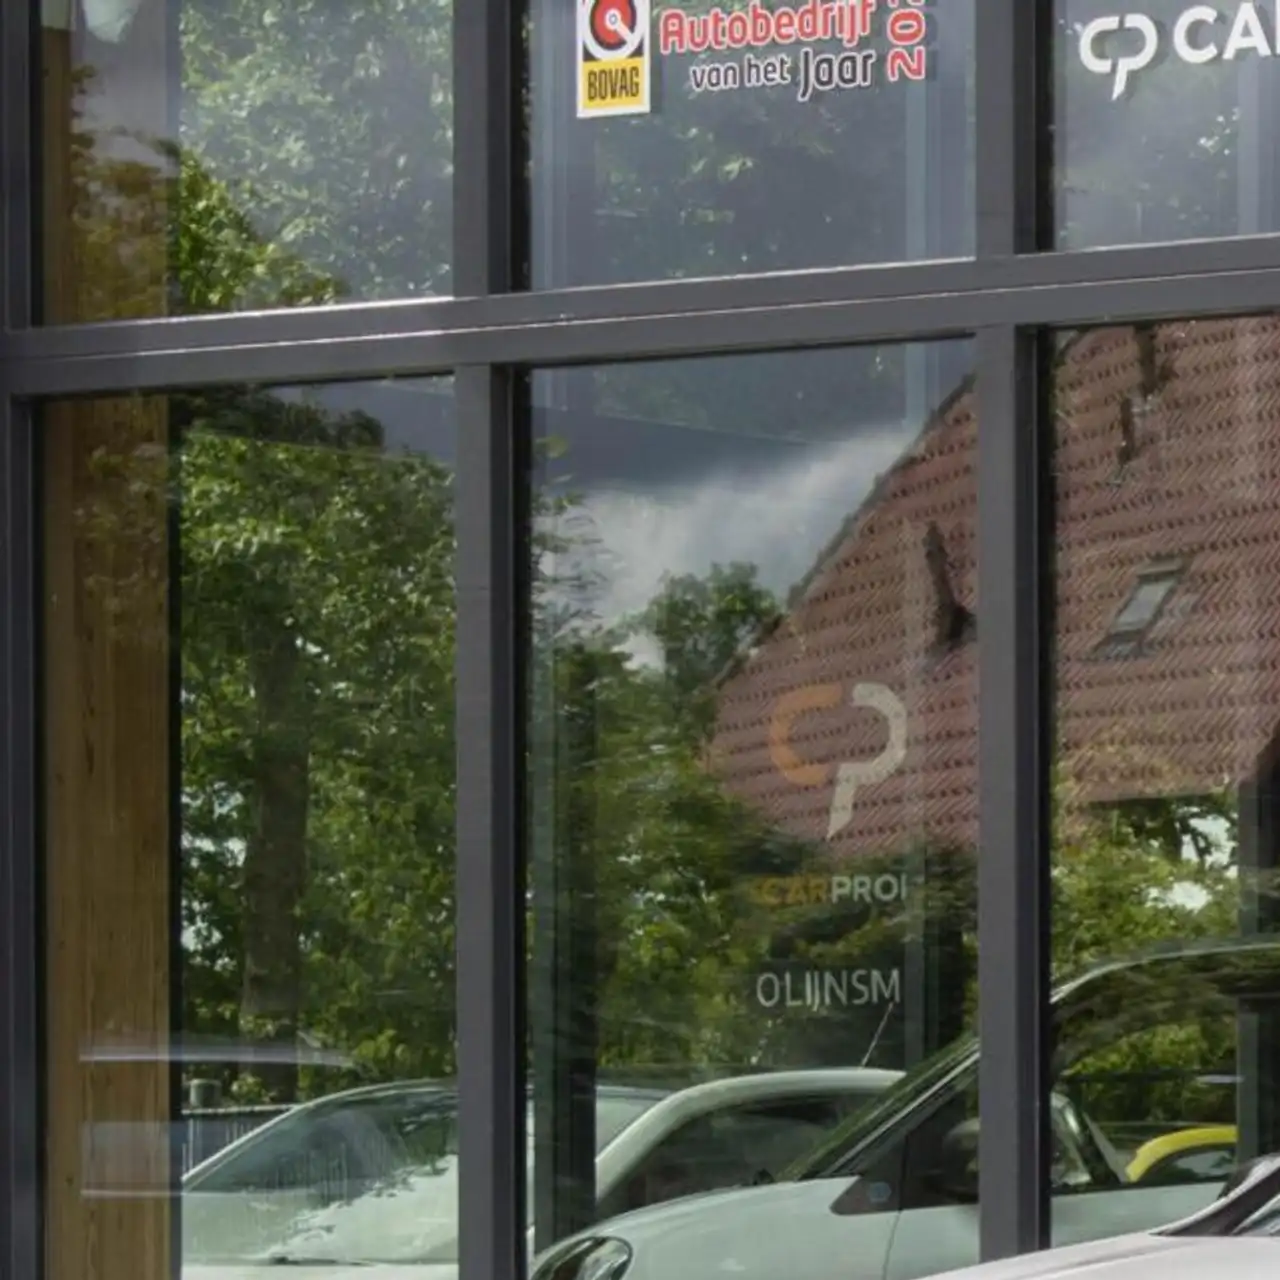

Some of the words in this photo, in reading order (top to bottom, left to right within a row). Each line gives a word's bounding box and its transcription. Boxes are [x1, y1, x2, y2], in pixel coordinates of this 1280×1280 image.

[587, 66, 640, 101] BOVAG
[691, 61, 738, 92] van
[745, 56, 791, 86] het
[797, 47, 876, 101] Jaar
